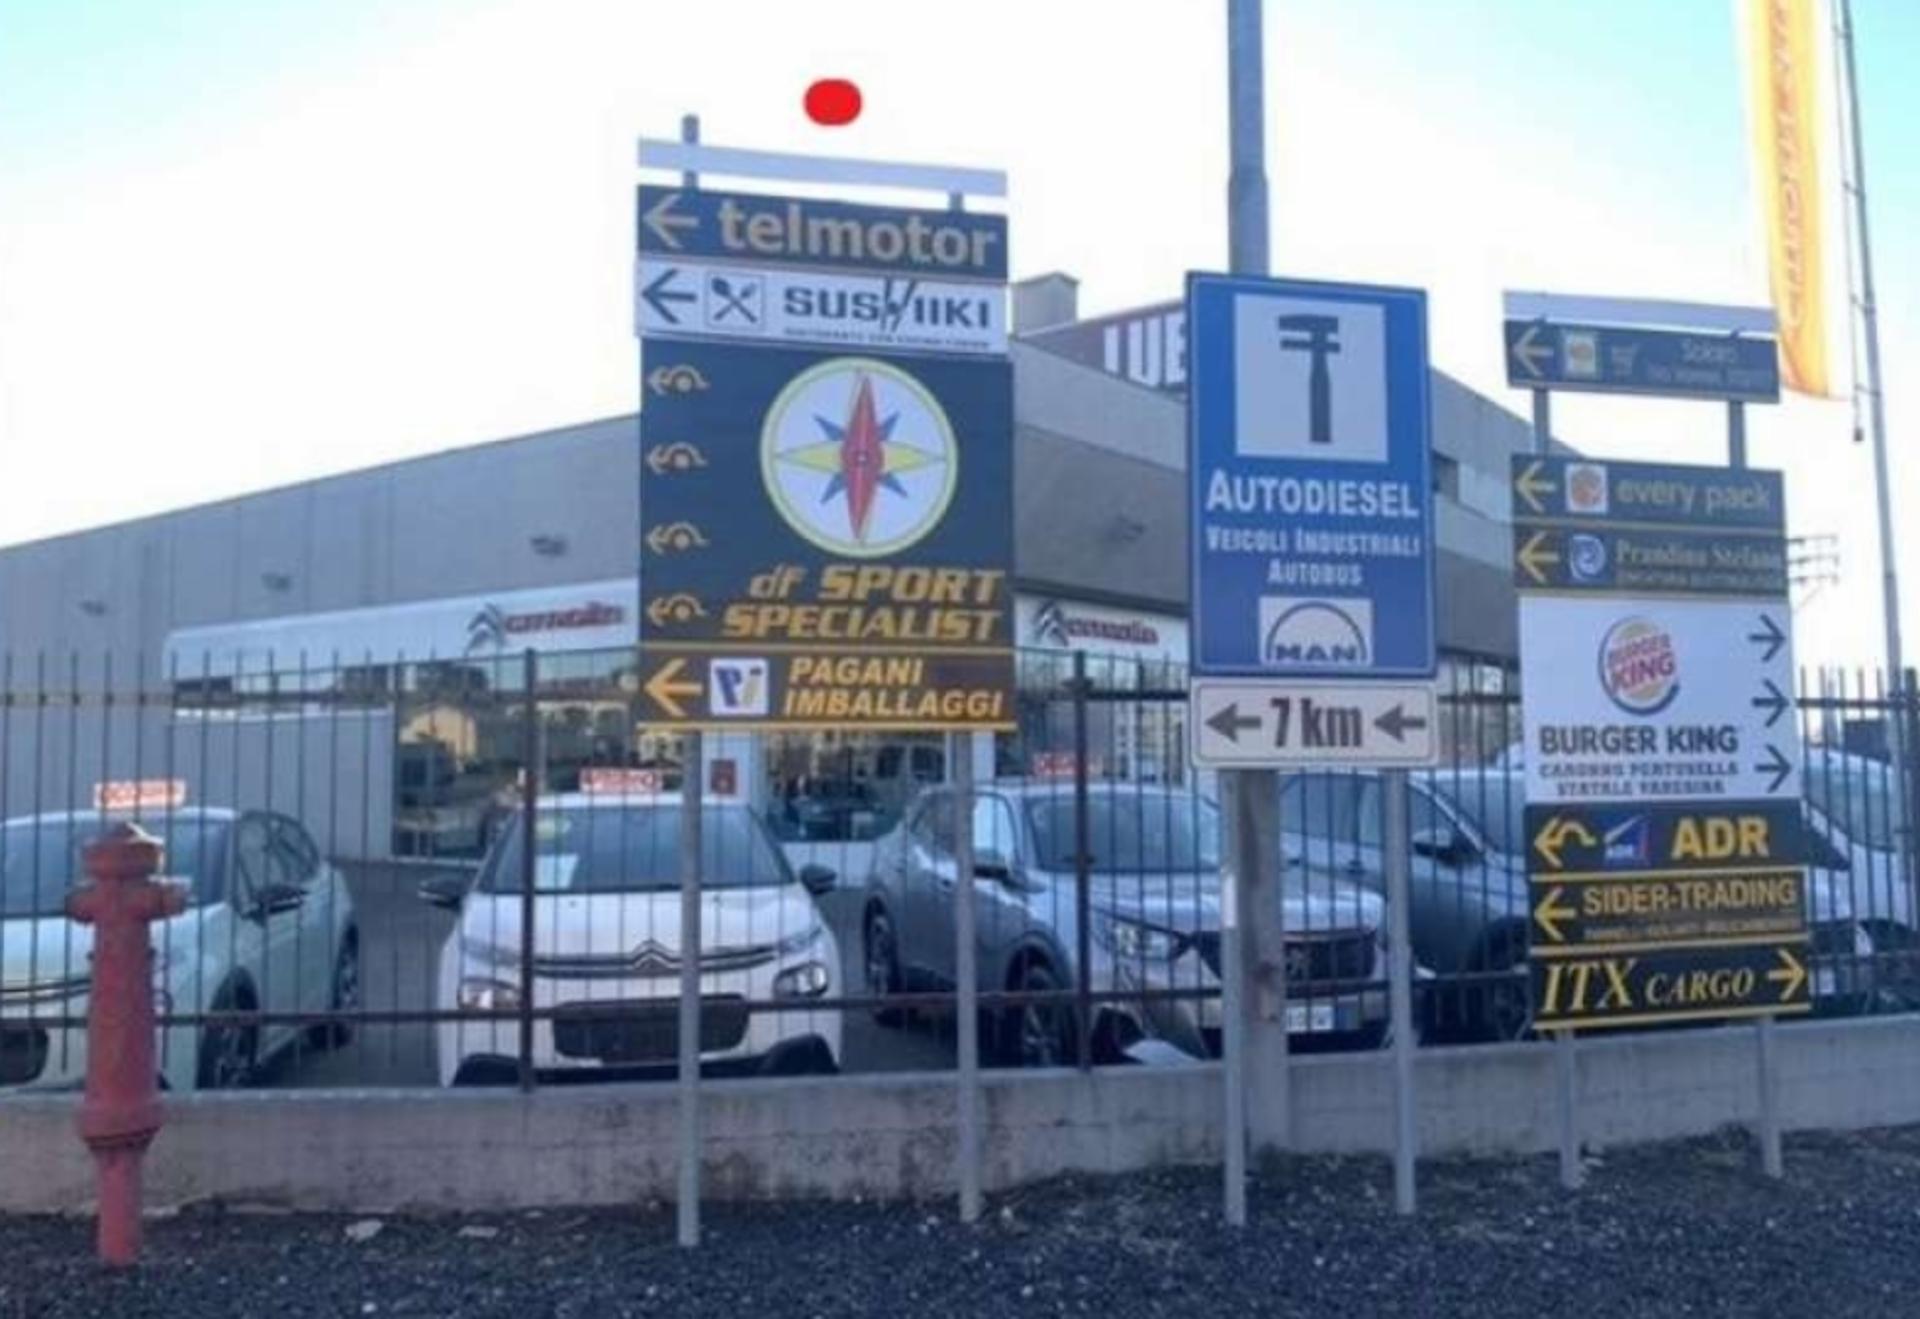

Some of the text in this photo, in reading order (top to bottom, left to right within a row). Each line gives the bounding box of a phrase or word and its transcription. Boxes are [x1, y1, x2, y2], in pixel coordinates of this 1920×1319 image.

[717, 199, 996, 266] telmotor
[1206, 469, 1419, 518] AUTODIESEL
[1616, 479, 1771, 516] every pack
[1206, 526, 1287, 553] VEICOLI
[818, 564, 1005, 603] SPORT
[1268, 561, 1362, 586] AUTOBUS
[722, 603, 1004, 641] SPECIALIST
[789, 656, 924, 684] PAGANI
[1273, 643, 1357, 662] MAN
[784, 689, 1004, 719] IMBALLAGGI
[1270, 697, 1363, 748] 7 km
[1539, 725, 1739, 754] BURGER KING
[1671, 816, 1769, 860] ADR
[1583, 879, 1797, 916] SIDER-TRADING
[1540, 957, 1755, 1013] ITX CARGO
